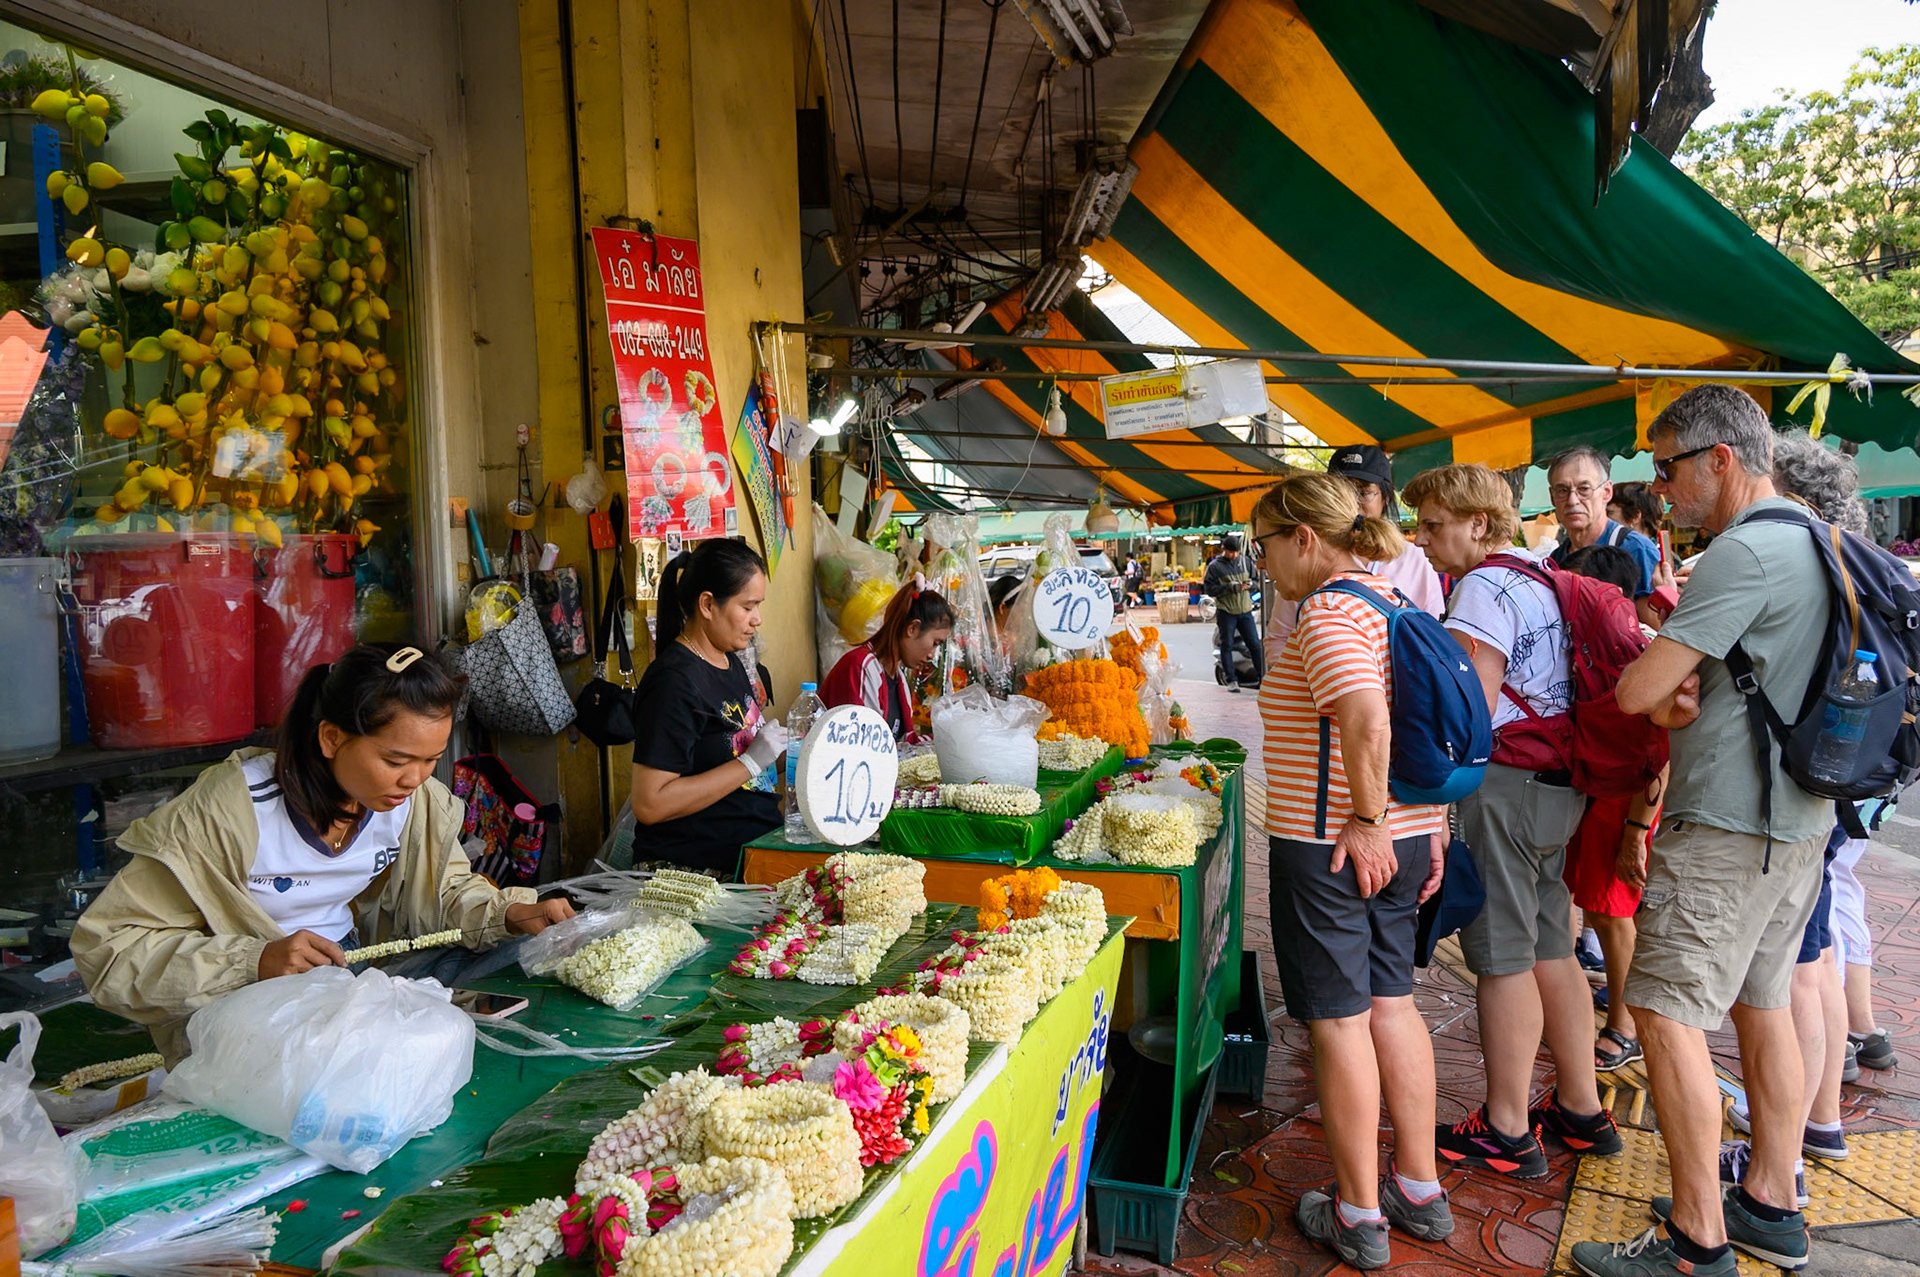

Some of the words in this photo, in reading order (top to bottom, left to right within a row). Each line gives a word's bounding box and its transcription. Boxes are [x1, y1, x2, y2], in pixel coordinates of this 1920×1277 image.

[642, 248, 699, 299] มาลัย
[616, 319, 705, 361] 062-698-2449
[1050, 591, 1091, 634] 10
[823, 757, 872, 826] 10
